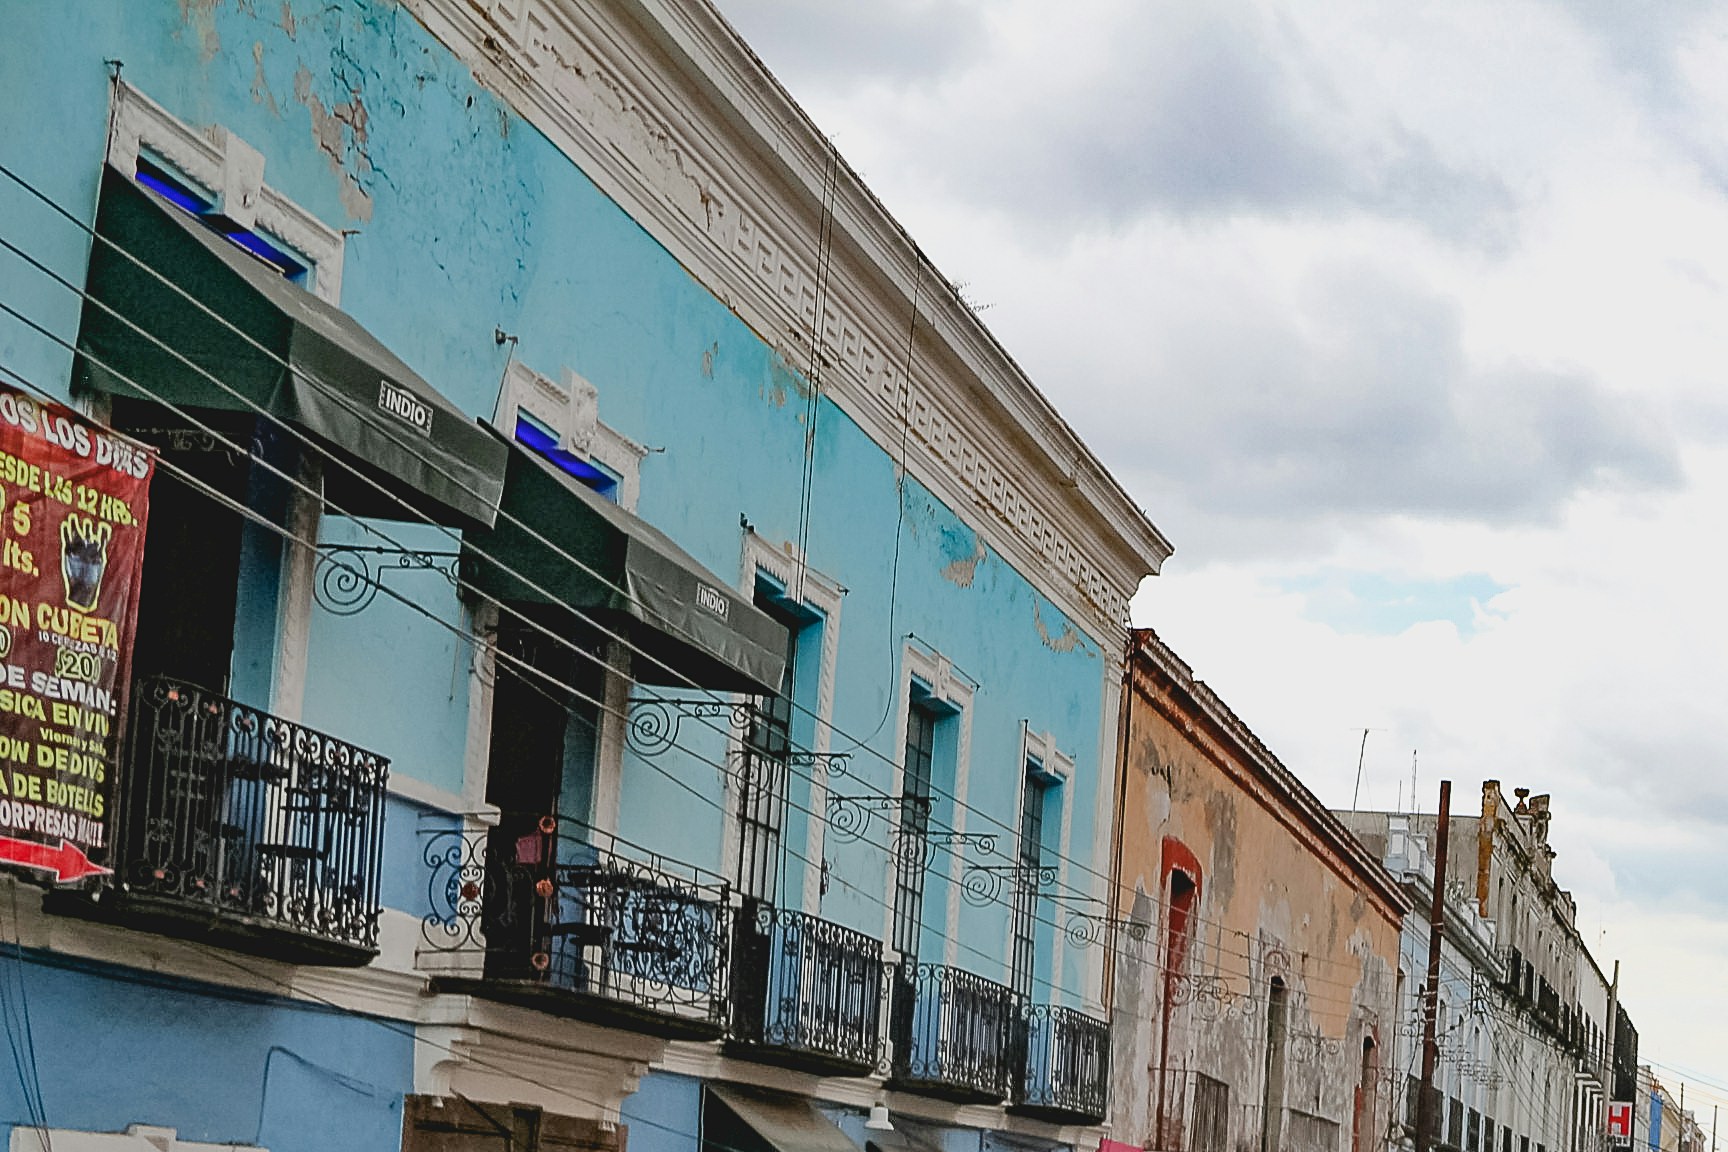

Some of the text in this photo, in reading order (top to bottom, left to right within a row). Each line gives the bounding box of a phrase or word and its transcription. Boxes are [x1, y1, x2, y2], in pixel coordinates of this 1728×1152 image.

[386, 388, 426, 426] INDIO
[41, 409, 91, 457] LOS
[76, 484, 98, 515] 12
[701, 588, 725, 615] INDIO
[37, 603, 118, 651] CUBETA
[13, 772, 42, 801] DE
